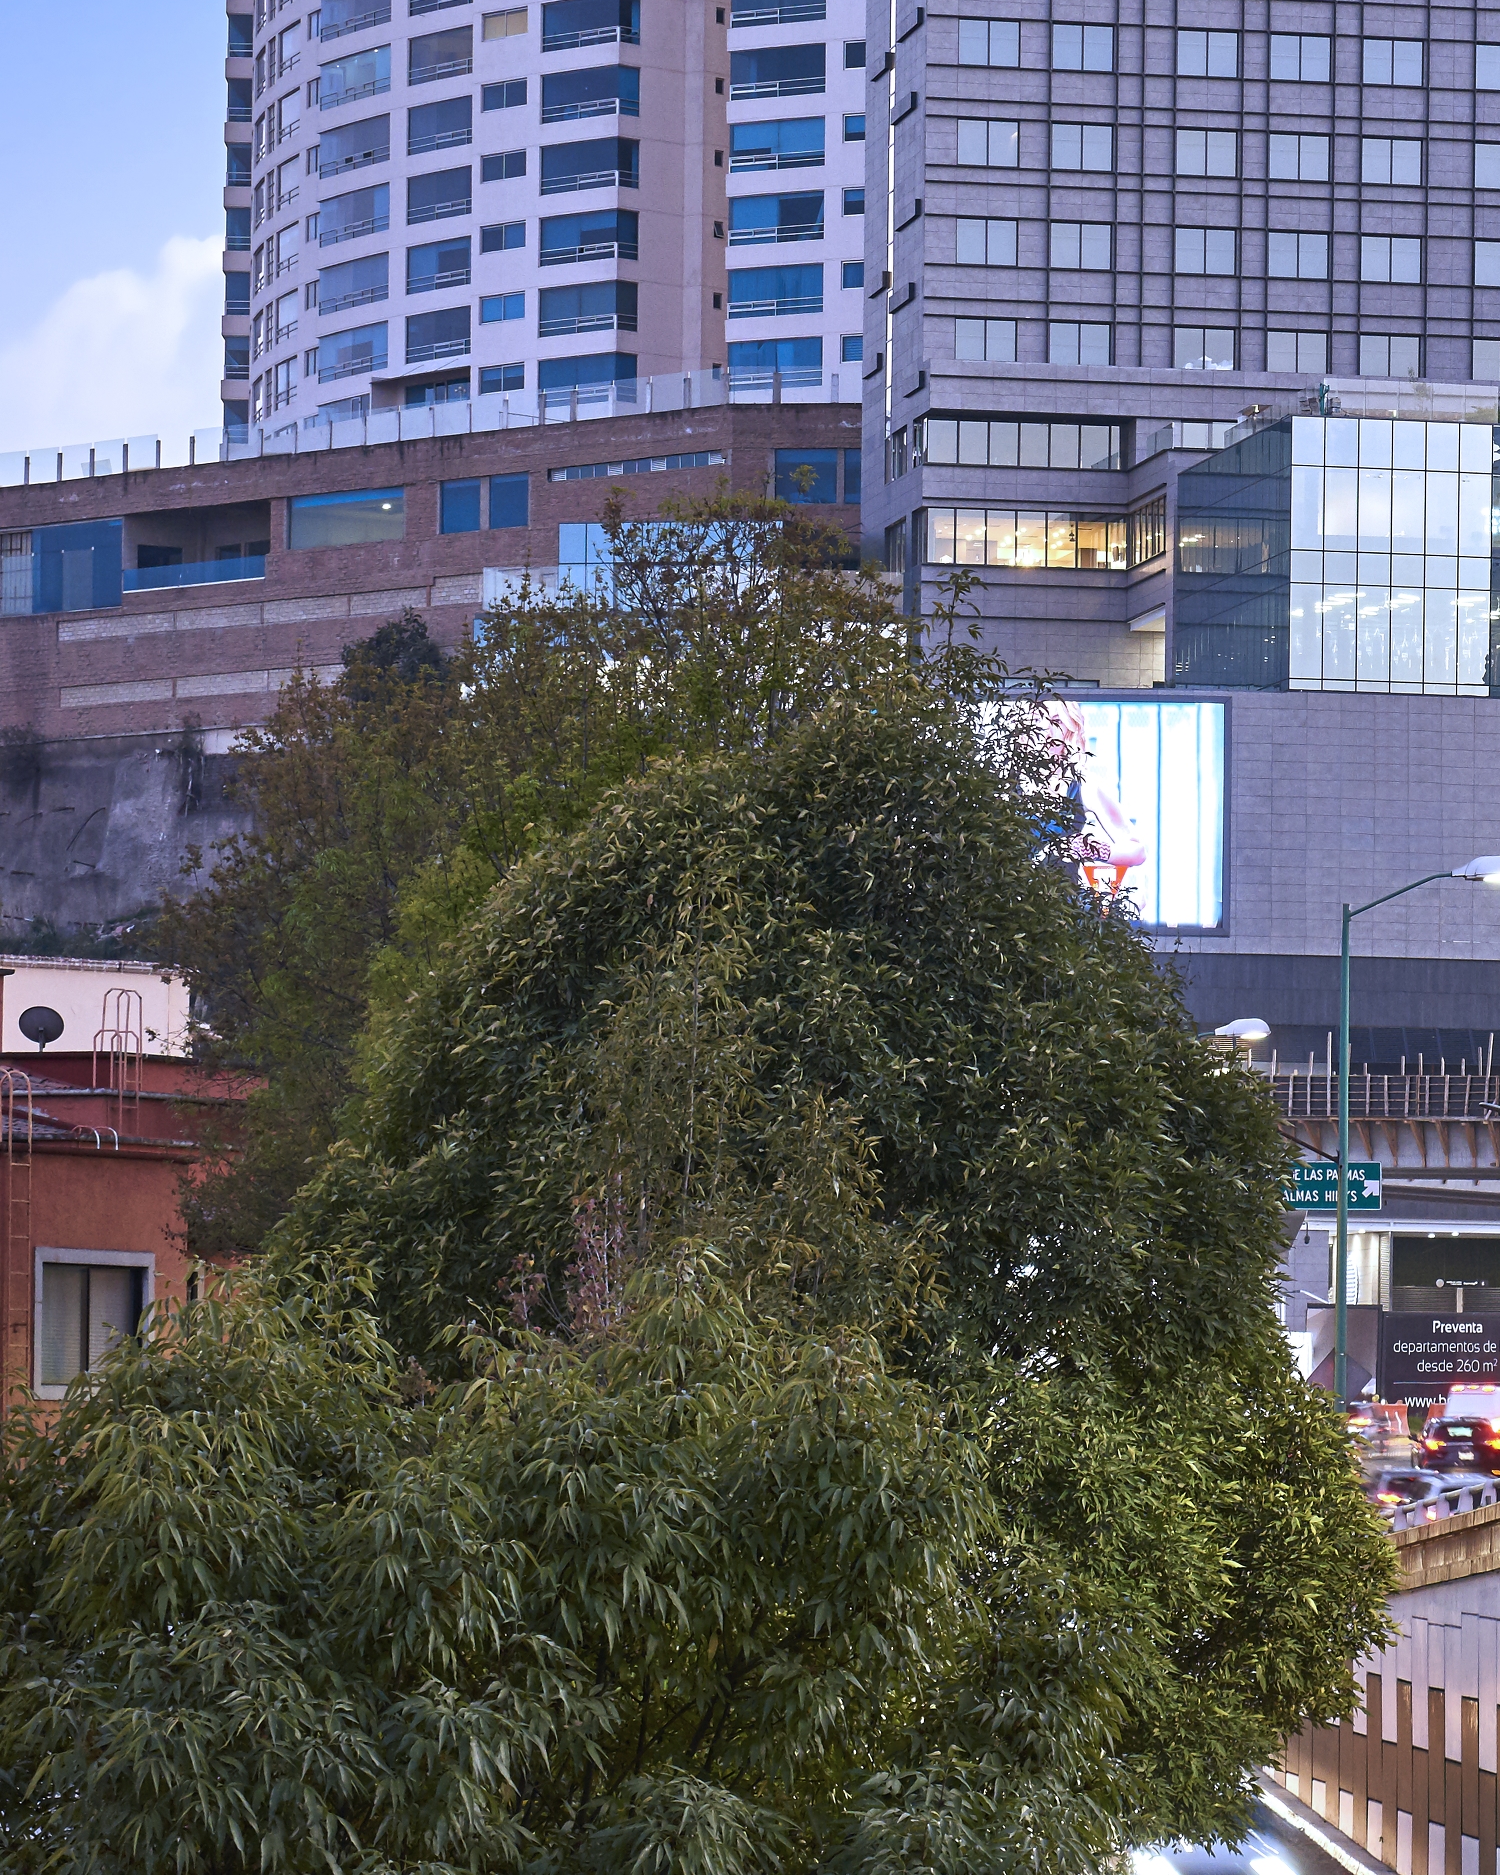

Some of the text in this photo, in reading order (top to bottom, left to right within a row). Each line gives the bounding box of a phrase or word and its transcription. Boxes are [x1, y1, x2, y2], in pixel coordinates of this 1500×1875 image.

[1304, 1169, 1323, 1181] LAS
[1326, 1169, 1365, 1181] PAMAS
[1282, 1189, 1319, 1202] ALMAS
[1432, 1320, 1483, 1333] Preventa
[1393, 1340, 1481, 1355] departamentos
[1483, 1340, 1497, 1353] de
[1416, 1359, 1454, 1372] desde
[1456, 1359, 1480, 1373] 260
